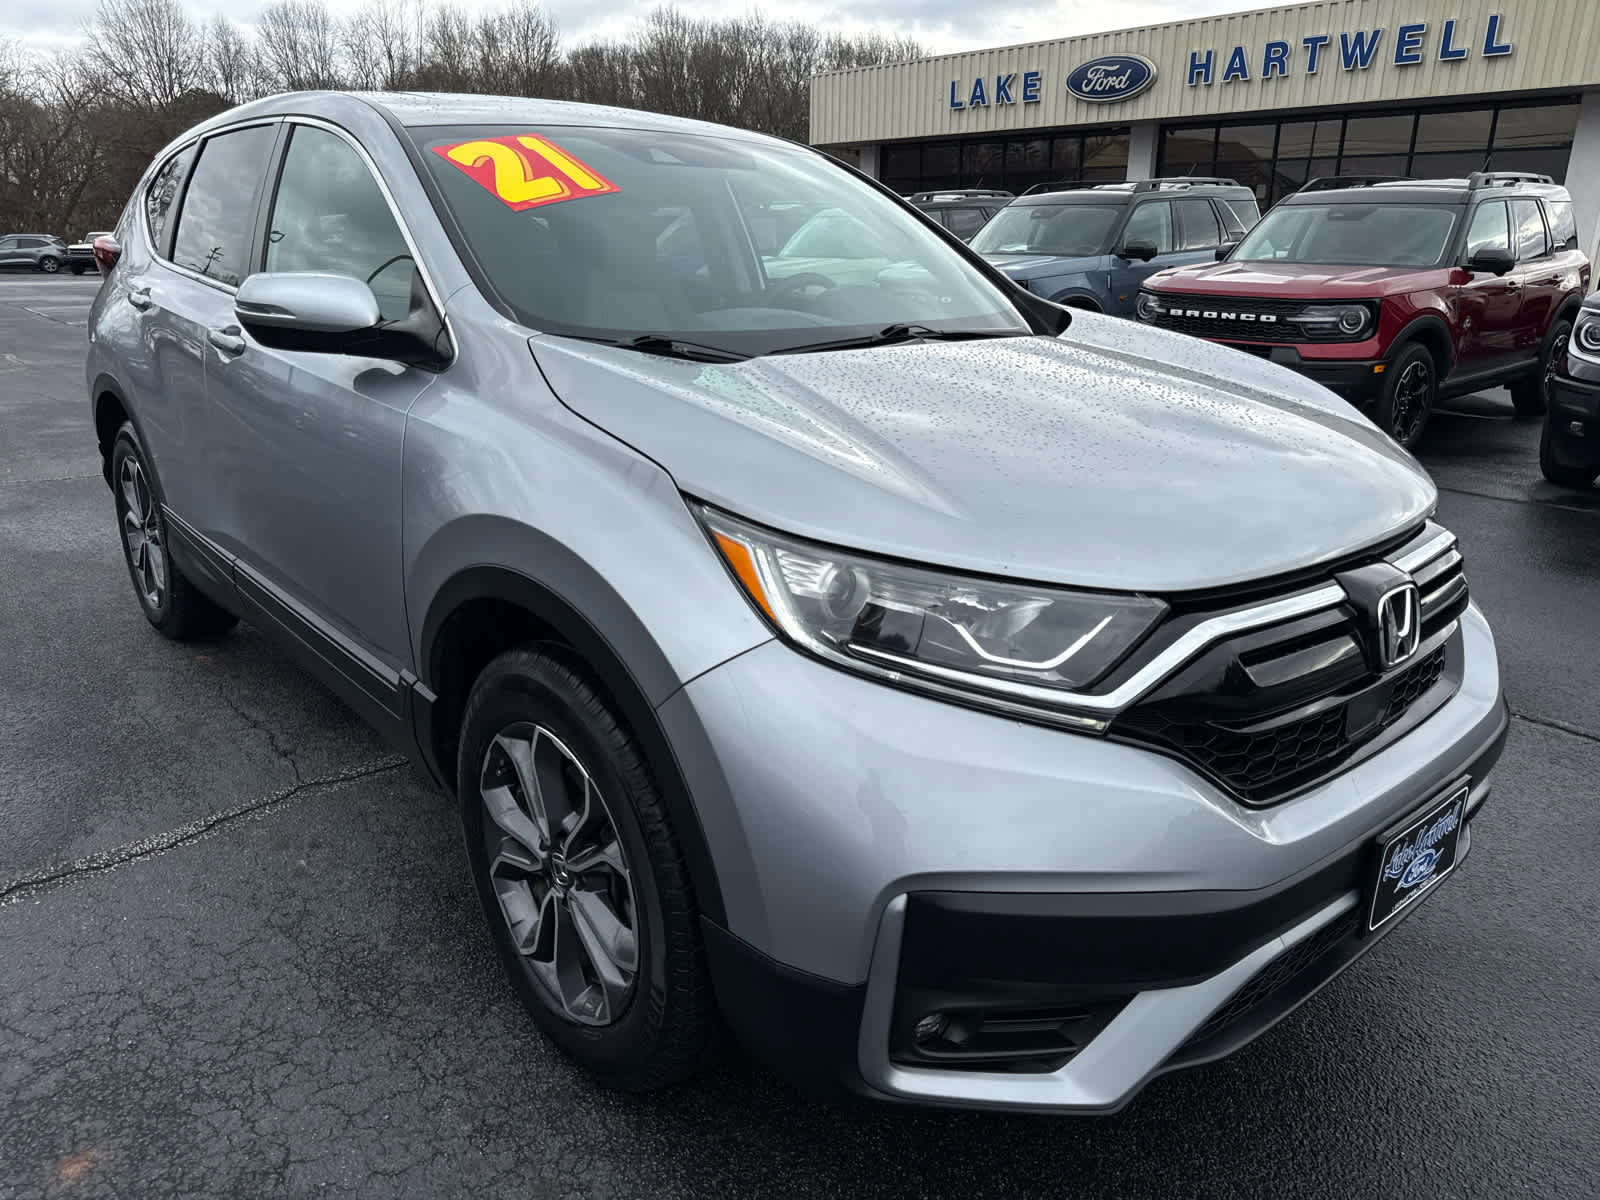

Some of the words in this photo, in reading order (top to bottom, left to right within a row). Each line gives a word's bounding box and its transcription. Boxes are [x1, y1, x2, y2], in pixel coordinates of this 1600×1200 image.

[950, 71, 1041, 110] LAKE
[1081, 63, 1133, 93] Ford
[1187, 14, 1513, 87] HARTWELL
[447, 136, 606, 204] 21
[1169, 308, 1277, 323] BRONCO
